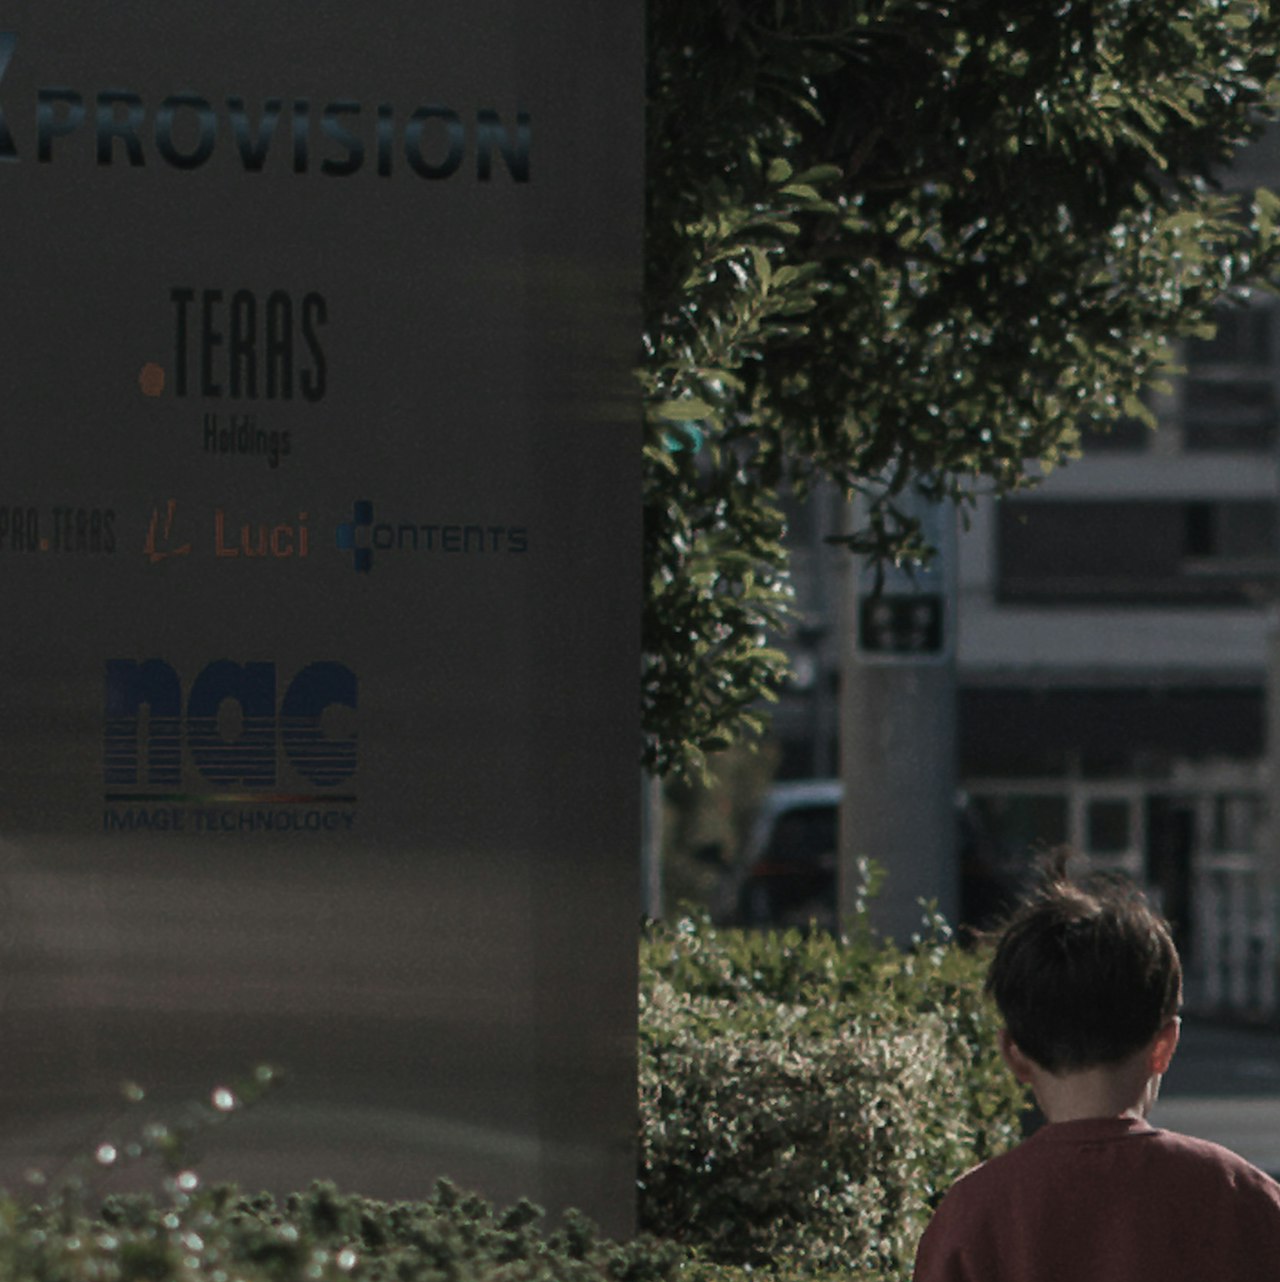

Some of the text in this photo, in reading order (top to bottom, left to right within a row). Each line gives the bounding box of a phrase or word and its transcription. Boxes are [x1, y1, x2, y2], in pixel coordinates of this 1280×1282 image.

[37, 84, 531, 184] PROVISION
[203, 413, 291, 468] Holdings
[214, 508, 309, 557] Luci
[103, 658, 359, 786] nac
[102, 808, 356, 833] IMAGE TECHNOLOGY
